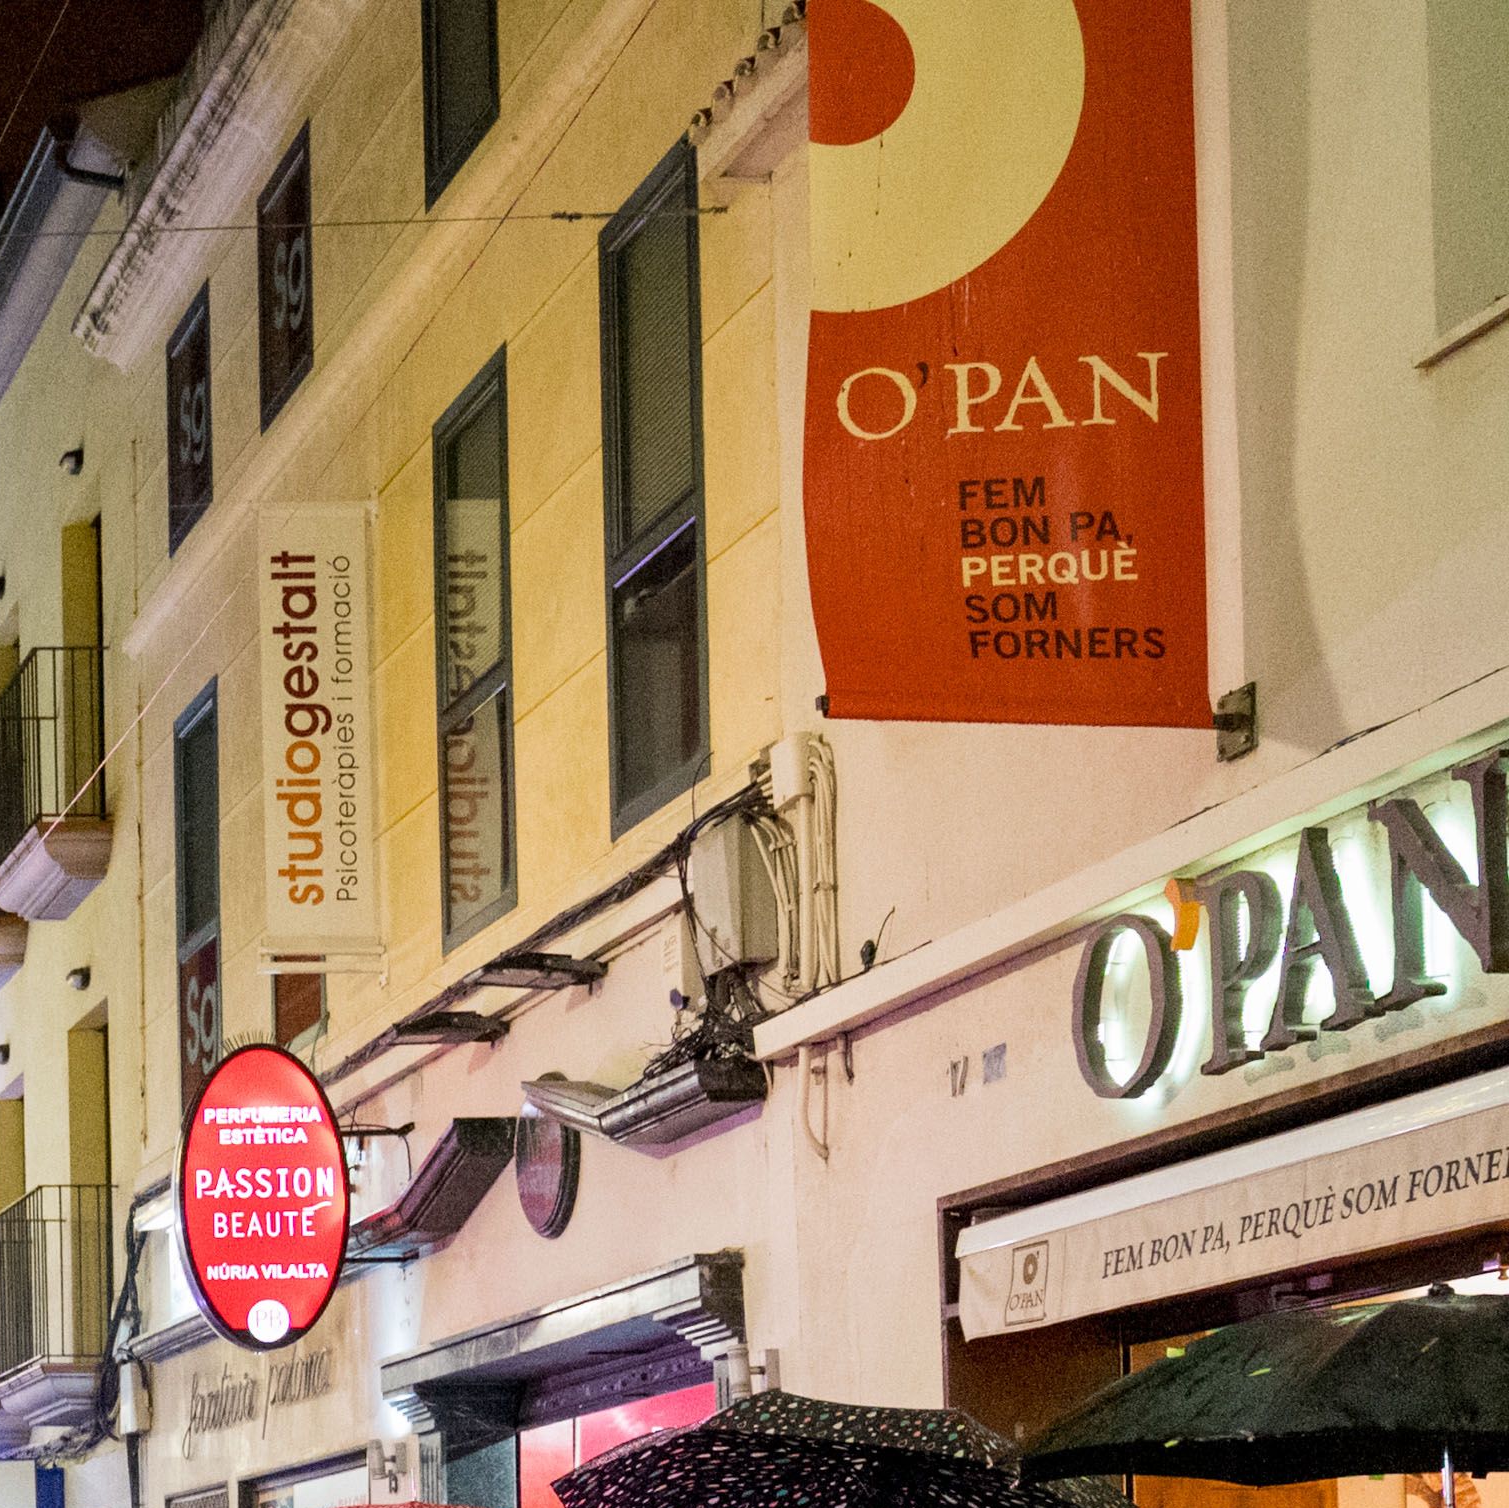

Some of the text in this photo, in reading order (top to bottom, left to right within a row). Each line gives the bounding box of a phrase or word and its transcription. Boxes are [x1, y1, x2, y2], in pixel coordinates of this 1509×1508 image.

[836, 351, 1169, 441] O'PAN
[957, 476, 1046, 511] FEM
[959, 511, 1133, 549] BON PA,
[961, 541, 1138, 588] PERQUÈ
[328, 555, 353, 684] formació
[964, 591, 1058, 625] SOM
[967, 627, 1167, 660] FORNERS
[270, 551, 332, 906] studiogestalt
[332, 712, 358, 901] Psicoteràpies
[1072, 749, 1509, 1100] O'PAN
[195, 1167, 335, 1199] PASSION
[1101, 1147, 1509, 1280] FEM BON PA, PERQUÈ SOM FORNE
[206, 1262, 329, 1281] NÚRIA VILALTA
